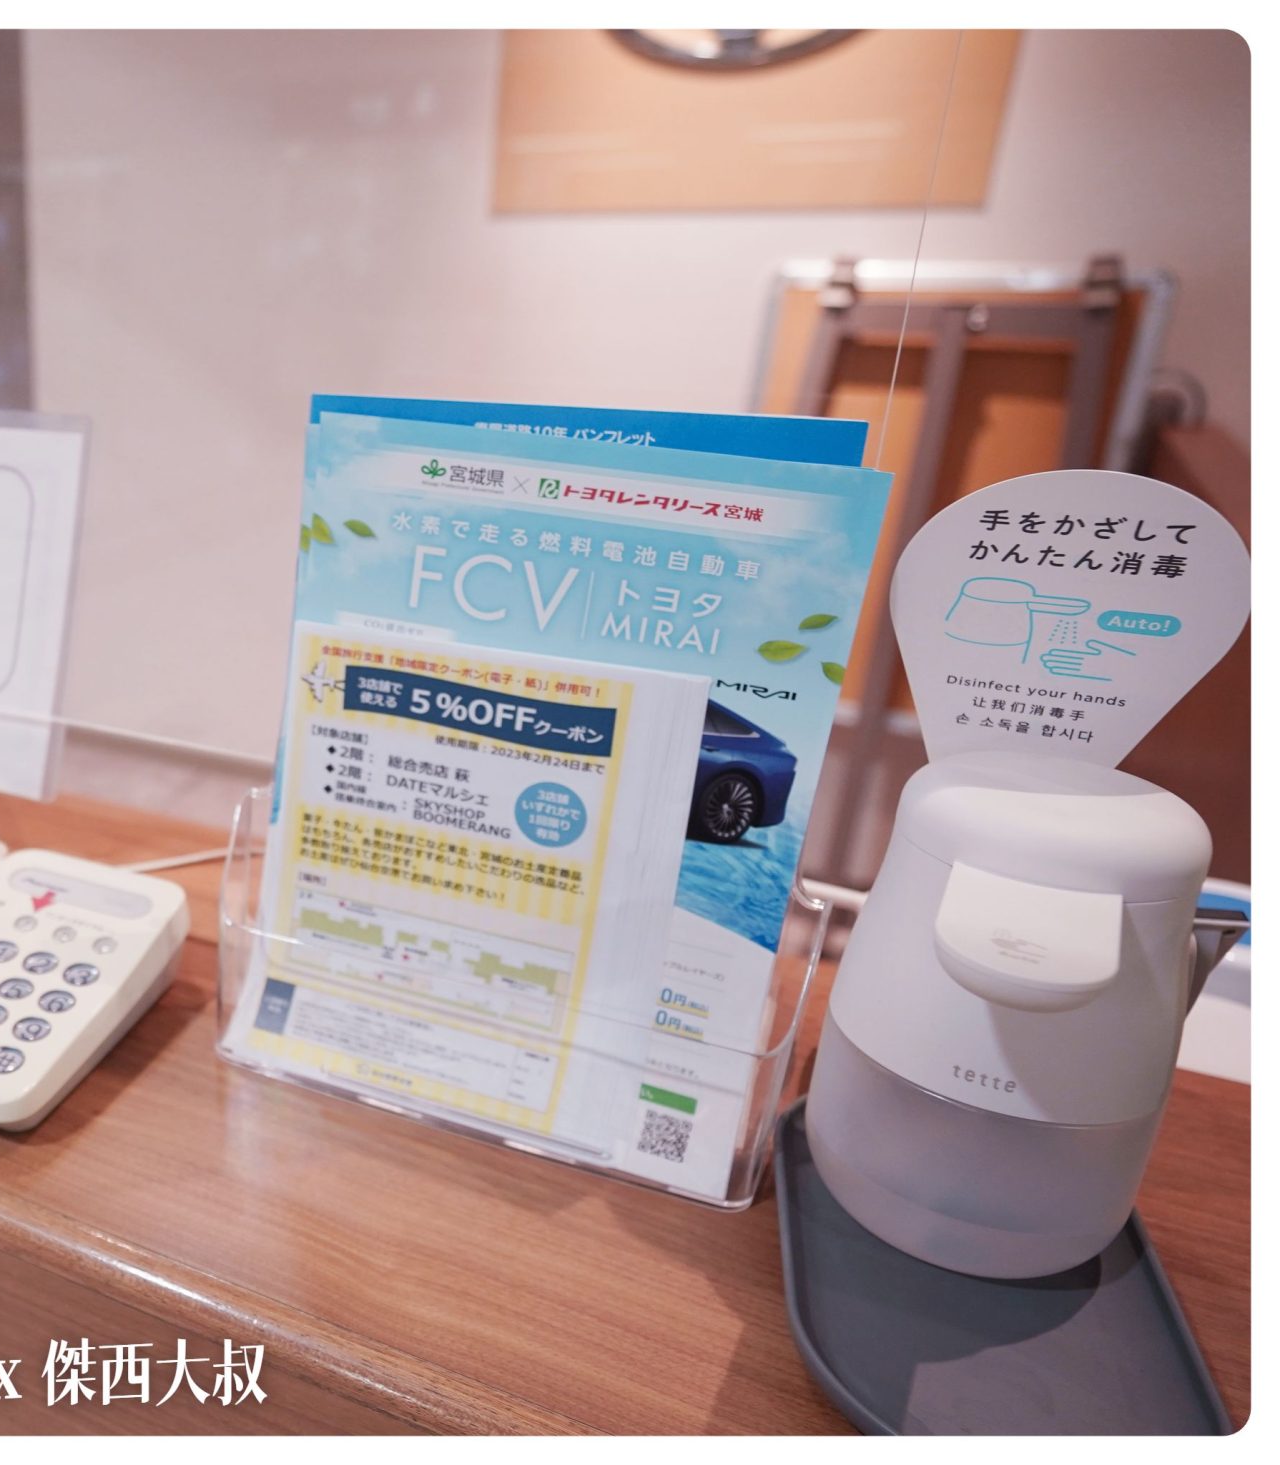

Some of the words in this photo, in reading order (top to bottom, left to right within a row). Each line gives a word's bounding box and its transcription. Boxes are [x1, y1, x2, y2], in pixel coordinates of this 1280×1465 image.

[449, 464, 504, 489] 宮城県
[564, 484, 765, 523] トヨタレンタリース宮城
[978, 509, 1197, 545] 手をかざして
[392, 512, 761, 581] 水素で走る燃料電池自動車
[969, 539, 1189, 580] かんたん消毒
[408, 544, 580, 633] FCV
[617, 579, 723, 618] トヨタ
[600, 611, 722, 656] MIRAI
[1107, 614, 1171, 633] Auto!
[360, 691, 399, 710] 使える
[946, 674, 1021, 695] Disinfect
[1027, 683, 1068, 701] your
[1073, 689, 1127, 708] hands
[972, 696, 1086, 722] 让我们消毒手
[979, 716, 1031, 736] 소독을
[1041, 723, 1095, 744] 합시다
[387, 754, 449, 780] 総合売店
[386, 774, 489, 808] DATEマルシェ
[413, 797, 486, 821] SKYSHOP
[413, 808, 512, 840] BOOMERANG
[952, 1063, 1017, 1095] tette
